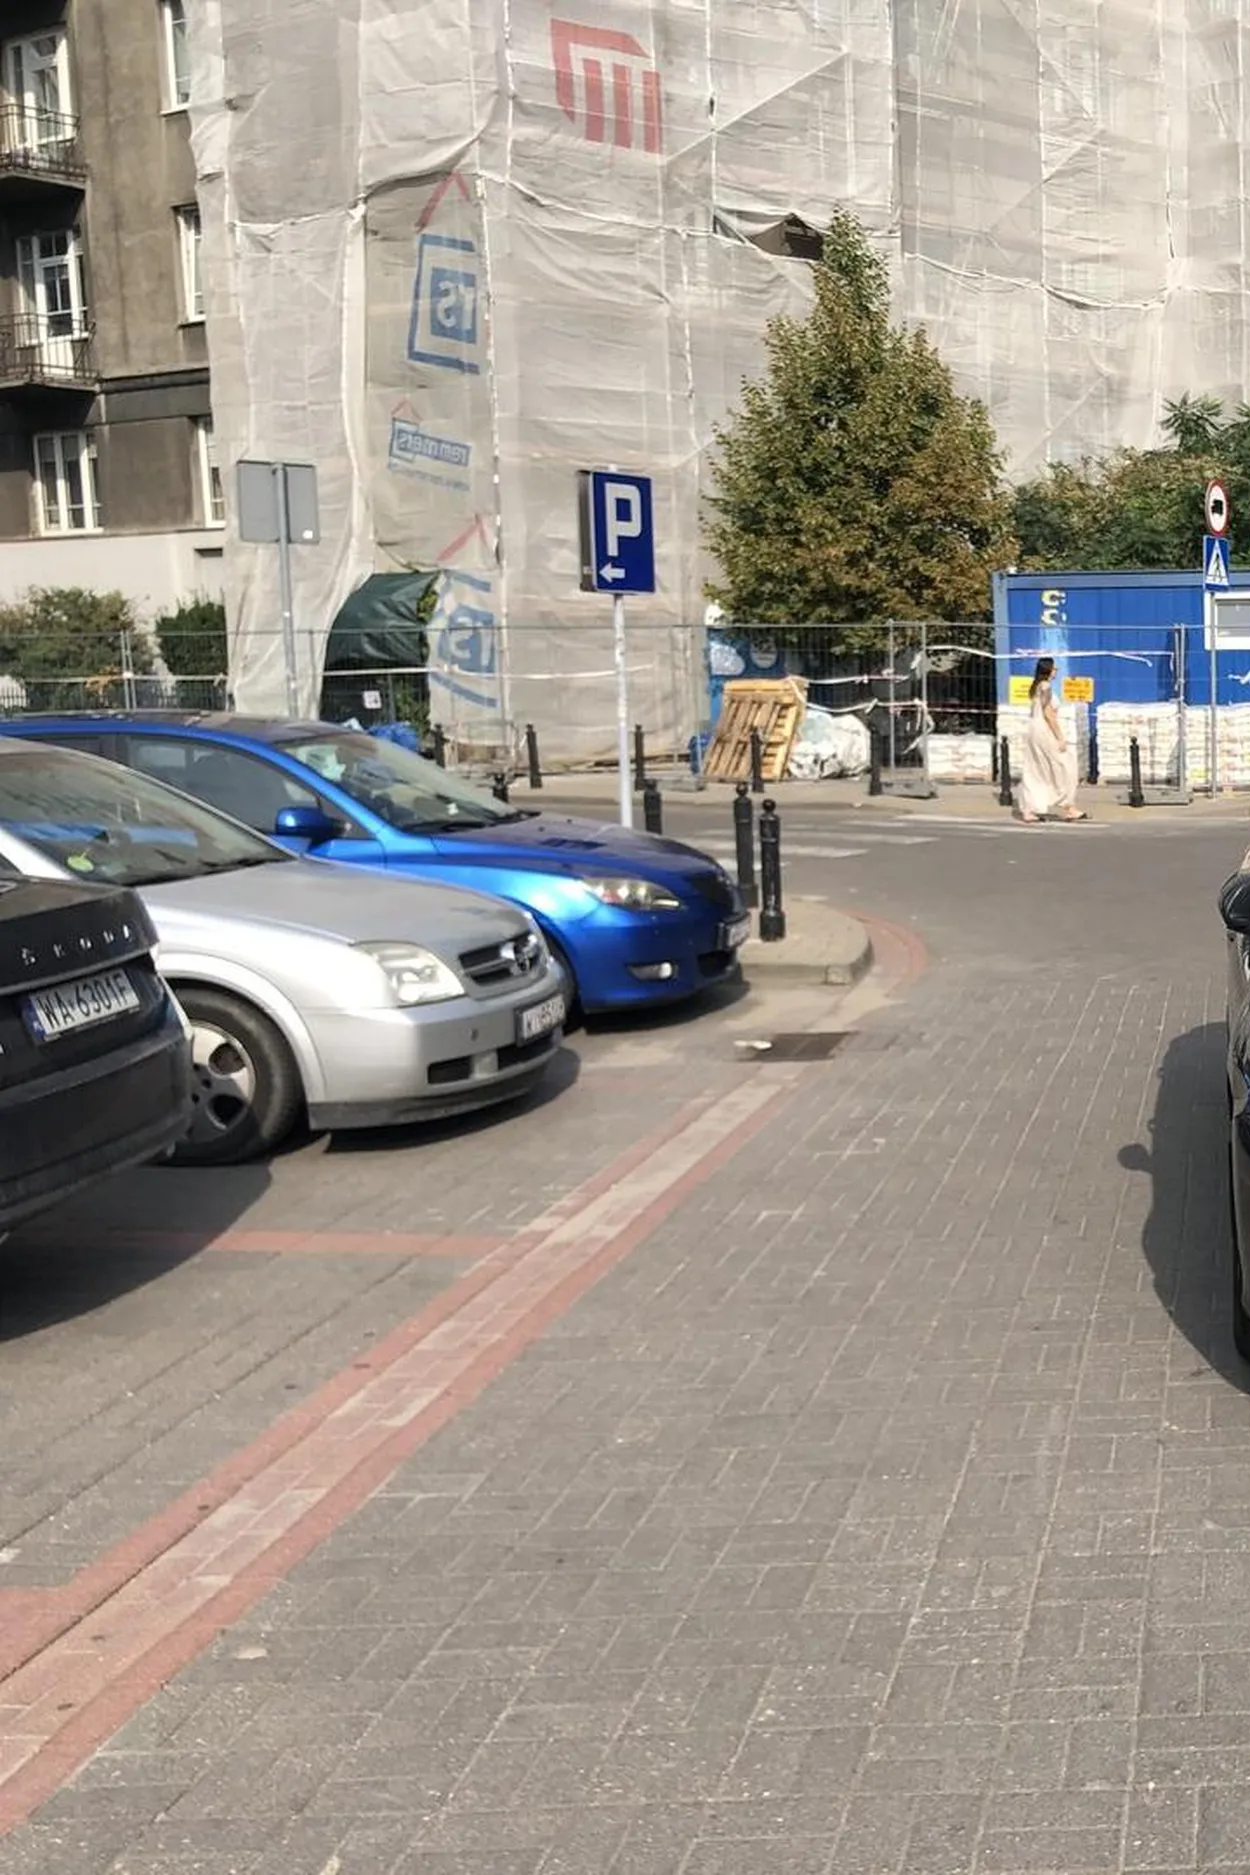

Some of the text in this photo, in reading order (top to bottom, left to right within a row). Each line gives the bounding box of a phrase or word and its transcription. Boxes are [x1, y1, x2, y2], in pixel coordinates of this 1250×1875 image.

[604, 482, 642, 556] P
[36, 972, 129, 1030] WA 6301F
